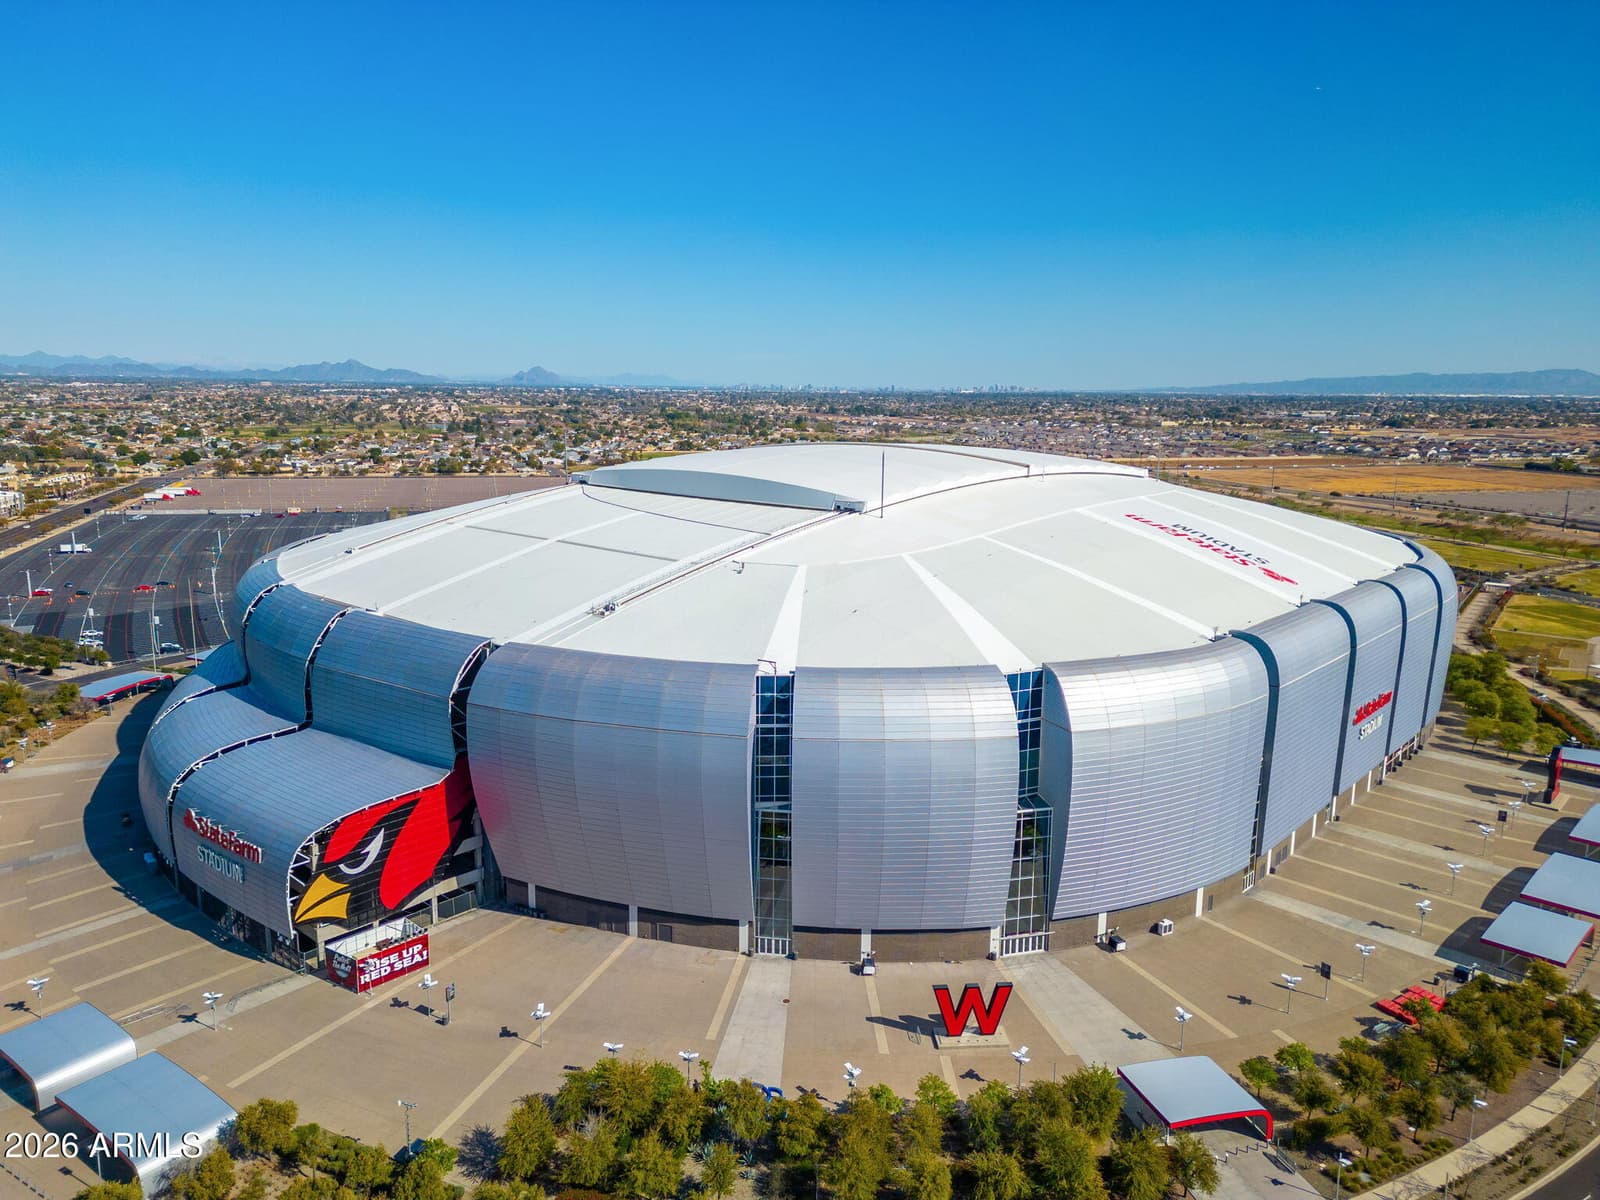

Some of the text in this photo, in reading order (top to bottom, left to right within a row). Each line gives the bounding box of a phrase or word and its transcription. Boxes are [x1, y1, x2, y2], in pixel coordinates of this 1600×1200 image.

[1172, 523, 1270, 565] STADIUM
[198, 845, 244, 884] STADIUM
[360, 966, 391, 985] RED
[393, 949, 428, 973] SEA!
[364, 954, 399, 973] RISE
[401, 944, 423, 958] UP
[932, 982, 1013, 1037] W
